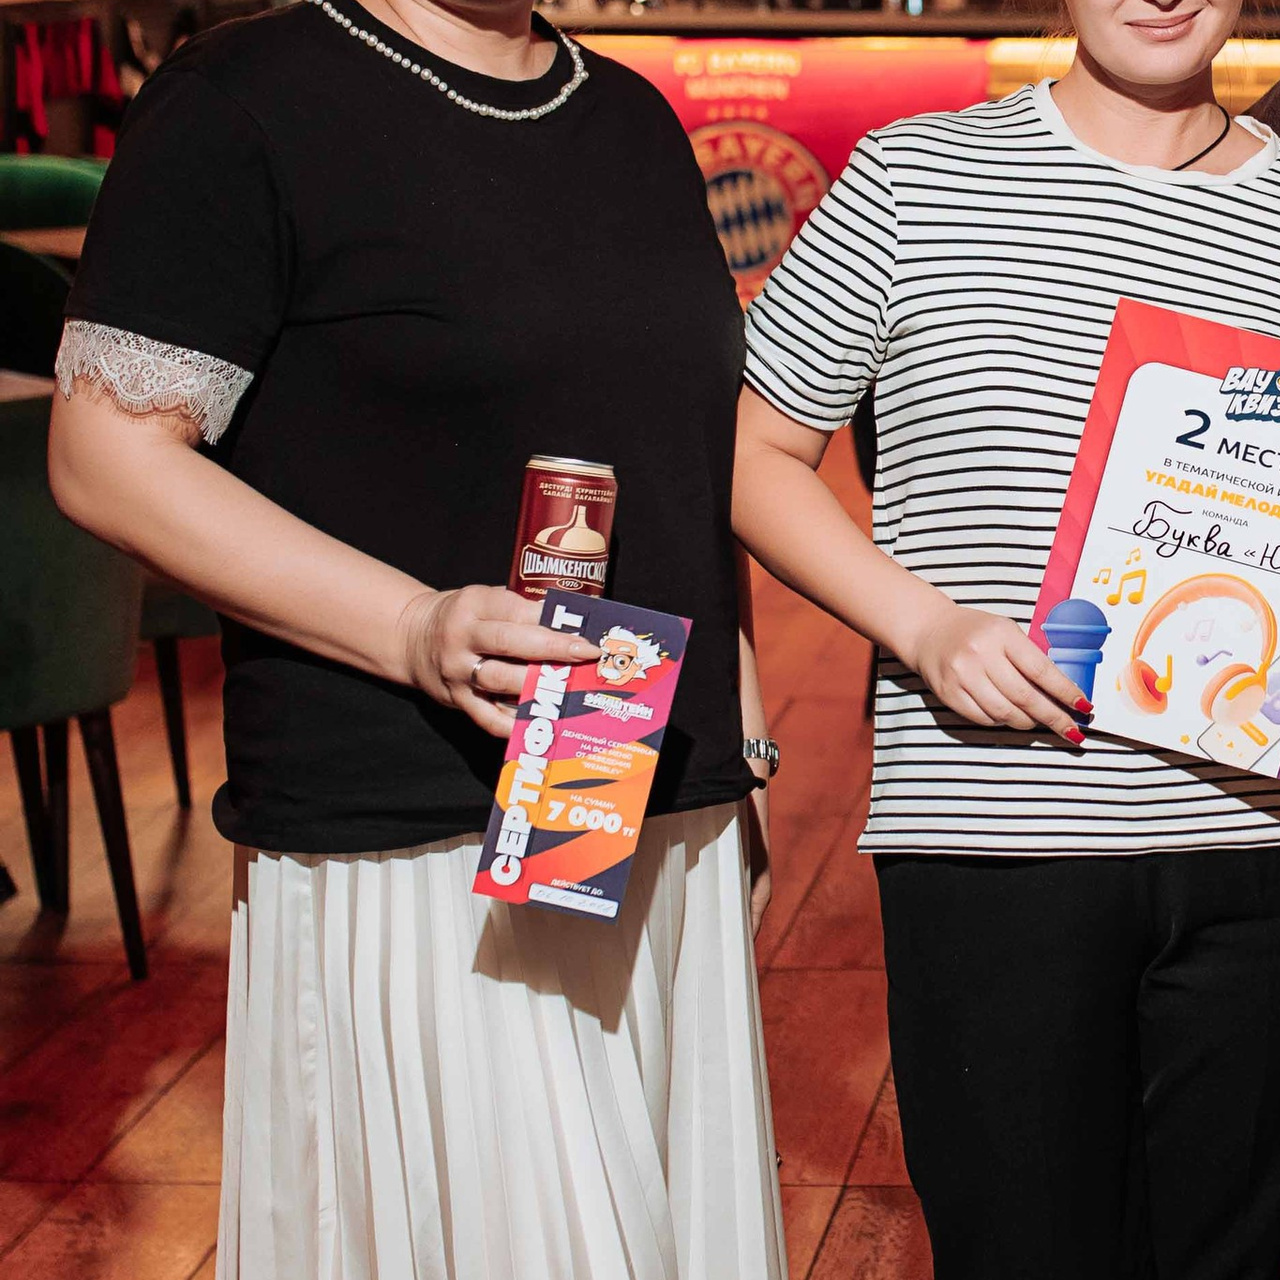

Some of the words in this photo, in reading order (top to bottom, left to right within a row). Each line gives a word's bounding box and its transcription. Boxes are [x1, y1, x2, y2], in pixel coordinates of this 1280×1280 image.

[1220, 366, 1276, 394] ВАУ
[1175, 409, 1211, 450] 2
[1145, 469, 1219, 500] УГАДАЙ
[1163, 457, 1173, 468] В
[1176, 460, 1275, 496] ТЕМАТИЧЕСКОЙ
[1133, 500, 1233, 558] Буква
[1201, 508, 1249, 528] КОМАНДА
[561, 580, 579, 588] 1976
[489, 604, 585, 887] СЕРТИФИКТ
[546, 801, 566, 821] 7
[567, 805, 623, 835] 000
[570, 793, 584, 804] НА
[584, 796, 617, 811] СУММУ
